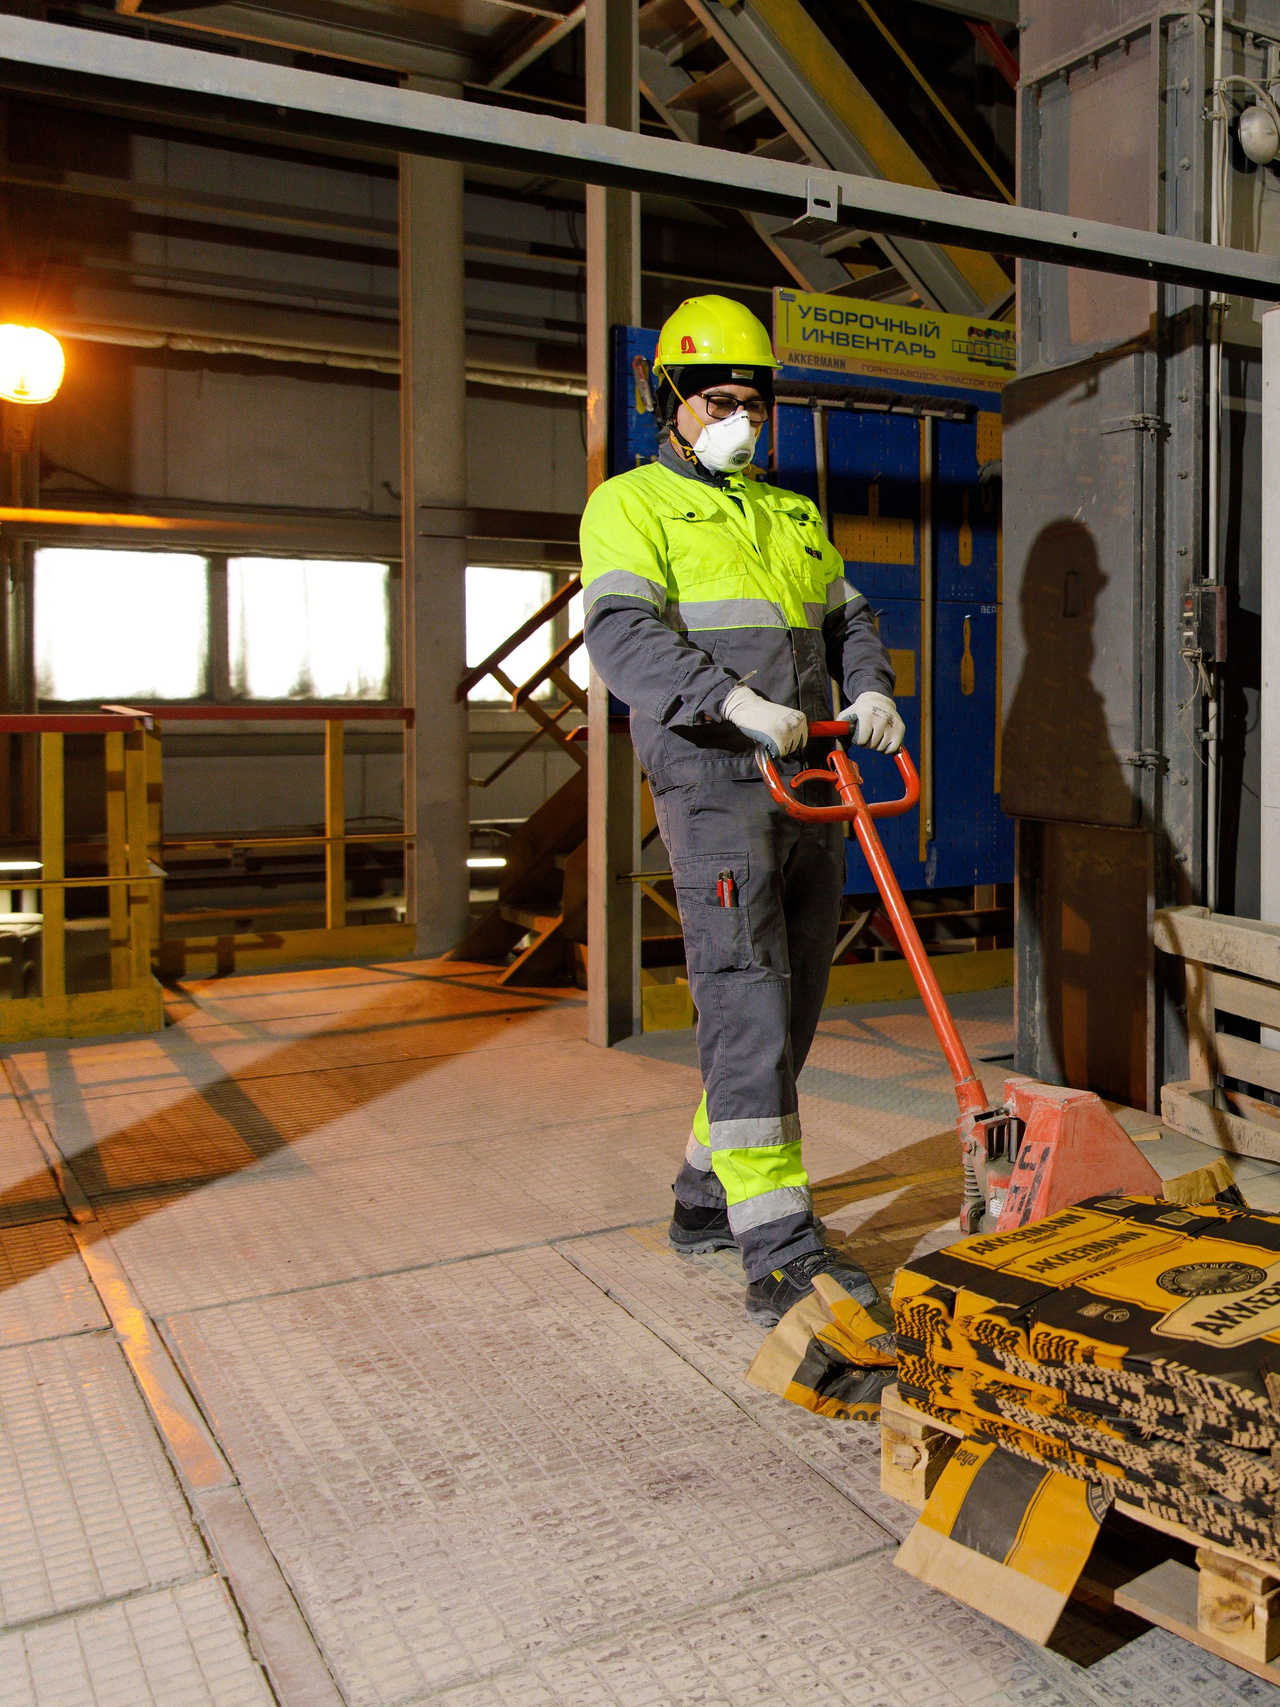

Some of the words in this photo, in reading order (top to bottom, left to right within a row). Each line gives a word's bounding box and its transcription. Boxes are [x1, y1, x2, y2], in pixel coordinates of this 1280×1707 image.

[797, 304, 940, 340] УБОРОЧНЫЙ
[802, 326, 937, 359] ИНВЕНТАРЬ
[787, 352, 847, 370] AKKERMANN
[966, 1212, 1087, 1256] AKKERMANN
[1024, 1230, 1149, 1275] AKKERMANN
